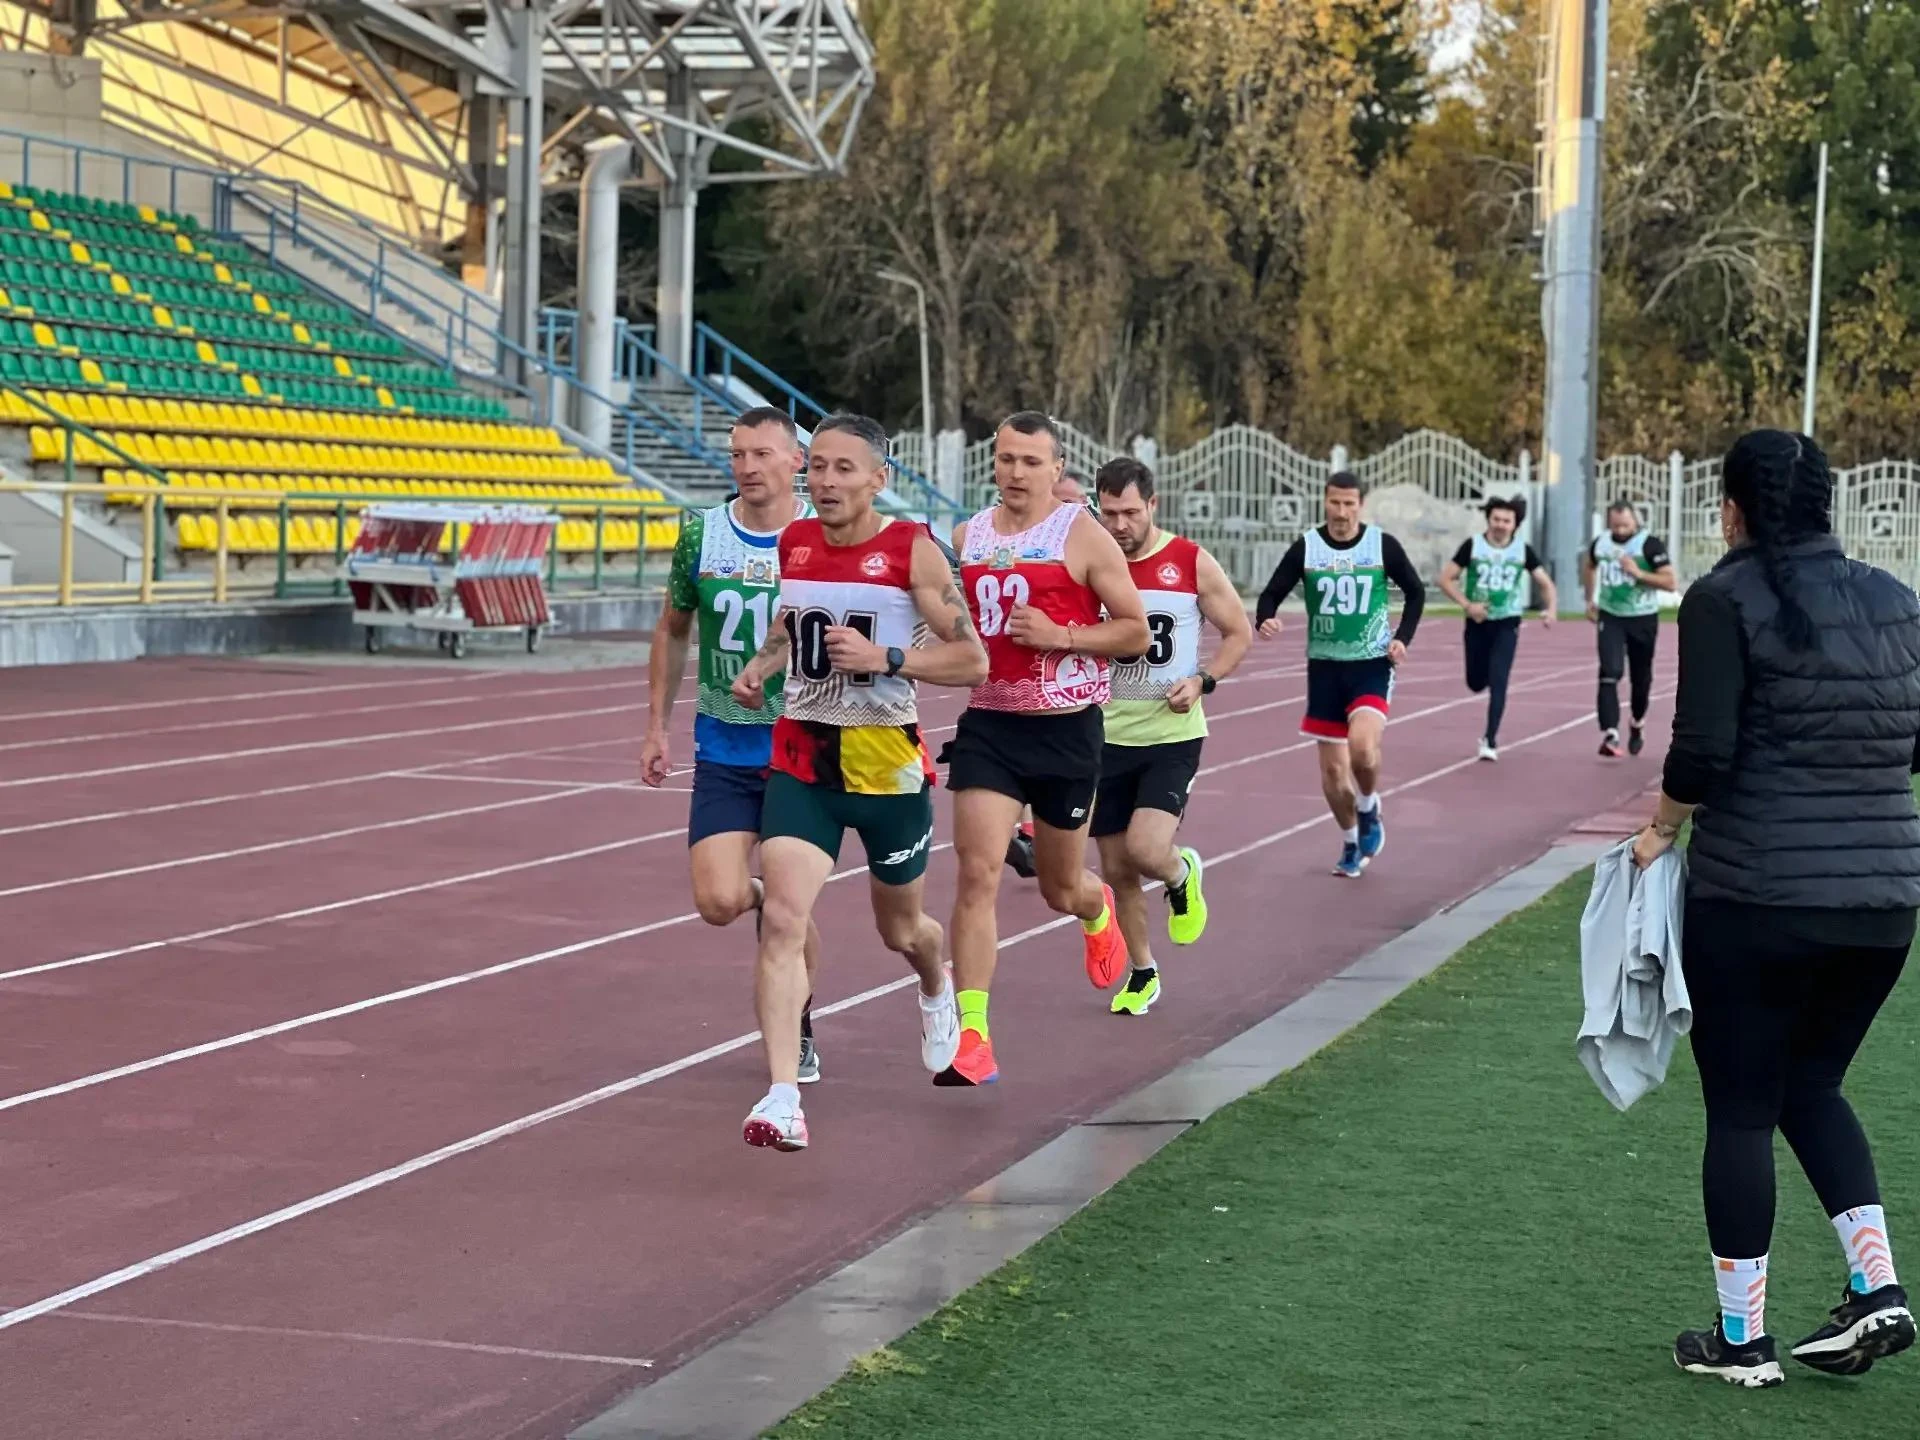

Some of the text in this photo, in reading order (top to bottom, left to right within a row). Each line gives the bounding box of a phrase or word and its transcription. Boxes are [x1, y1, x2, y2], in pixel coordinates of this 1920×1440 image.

[714, 590, 781, 651] 21
[976, 573, 1029, 637] 82
[1317, 575, 1373, 616] 297
[1072, 683, 1095, 698] ГТО
